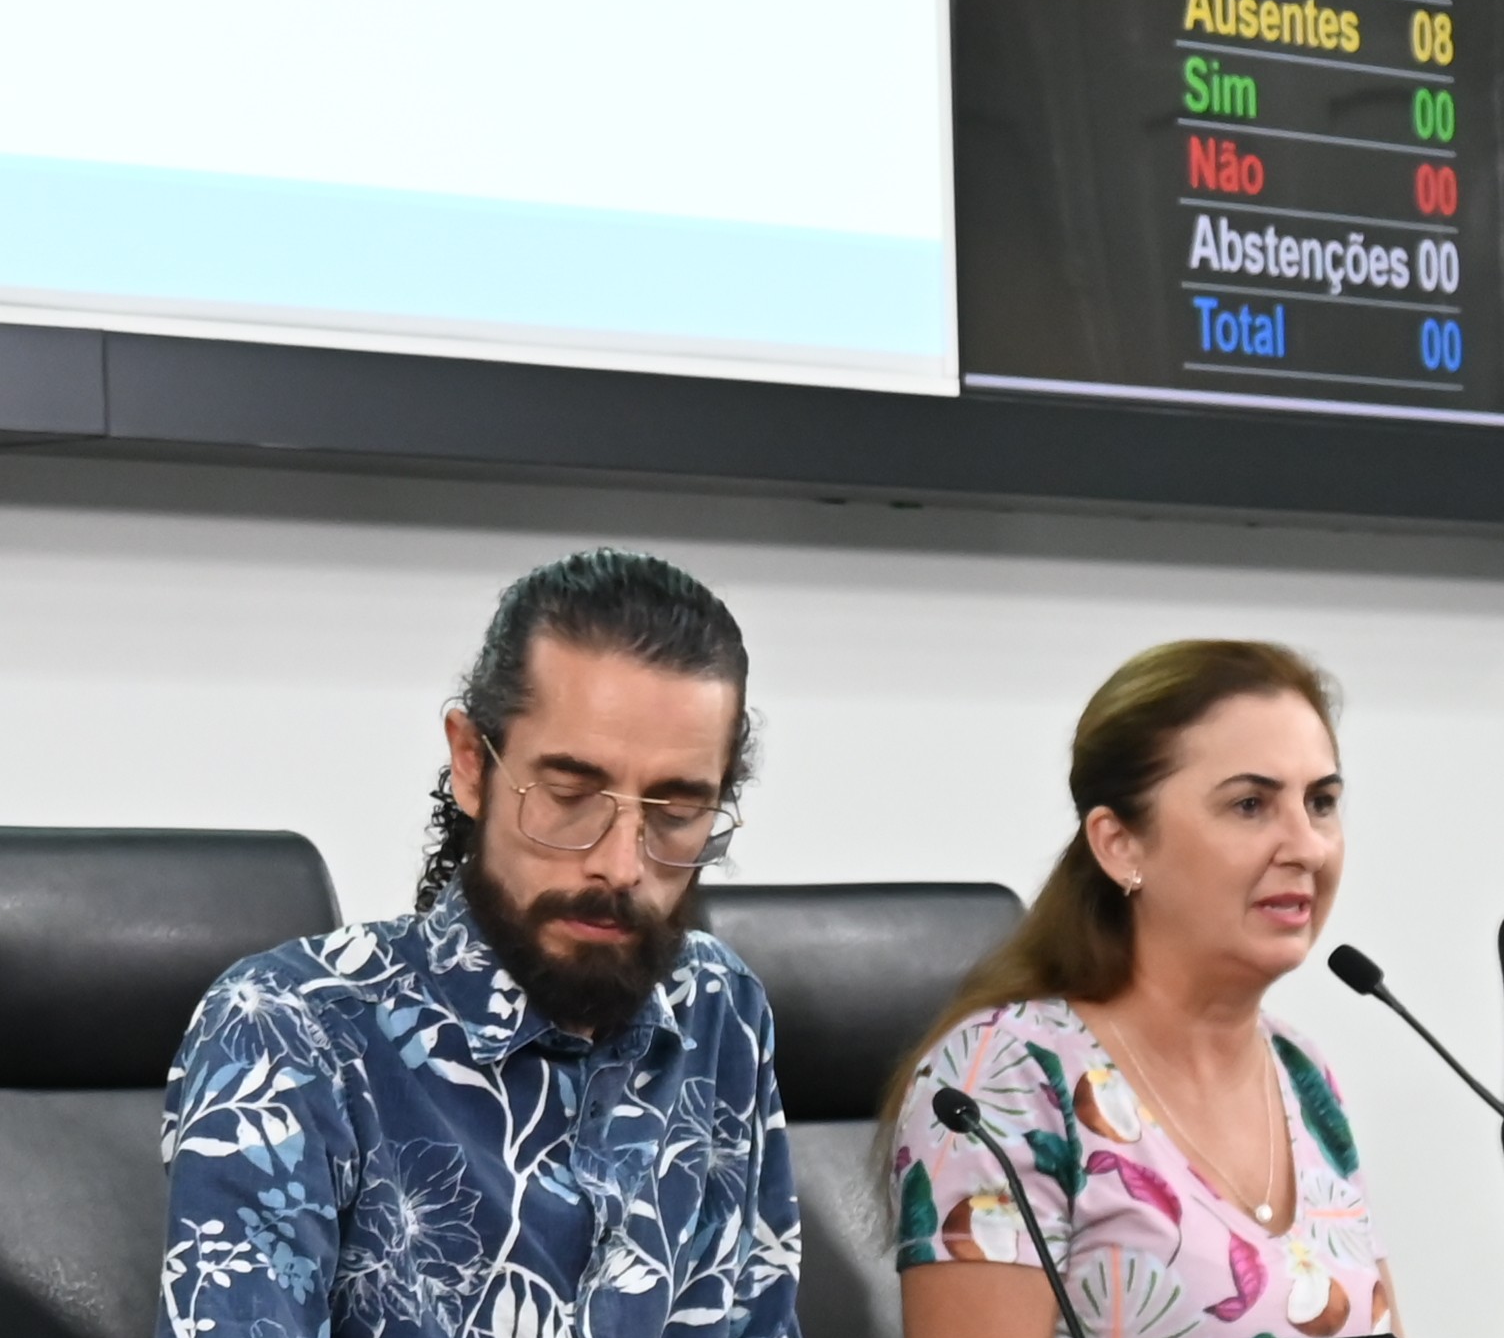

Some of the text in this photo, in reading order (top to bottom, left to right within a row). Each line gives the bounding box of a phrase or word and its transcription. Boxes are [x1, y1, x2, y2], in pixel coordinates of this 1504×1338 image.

[1412, 10, 1454, 66] 08
[1183, 55, 1455, 143] Sim 00
[1188, 135, 1458, 217] Não 00
[1189, 213, 1460, 295] Abstenções 00
[1193, 297, 1463, 372] Total 00
